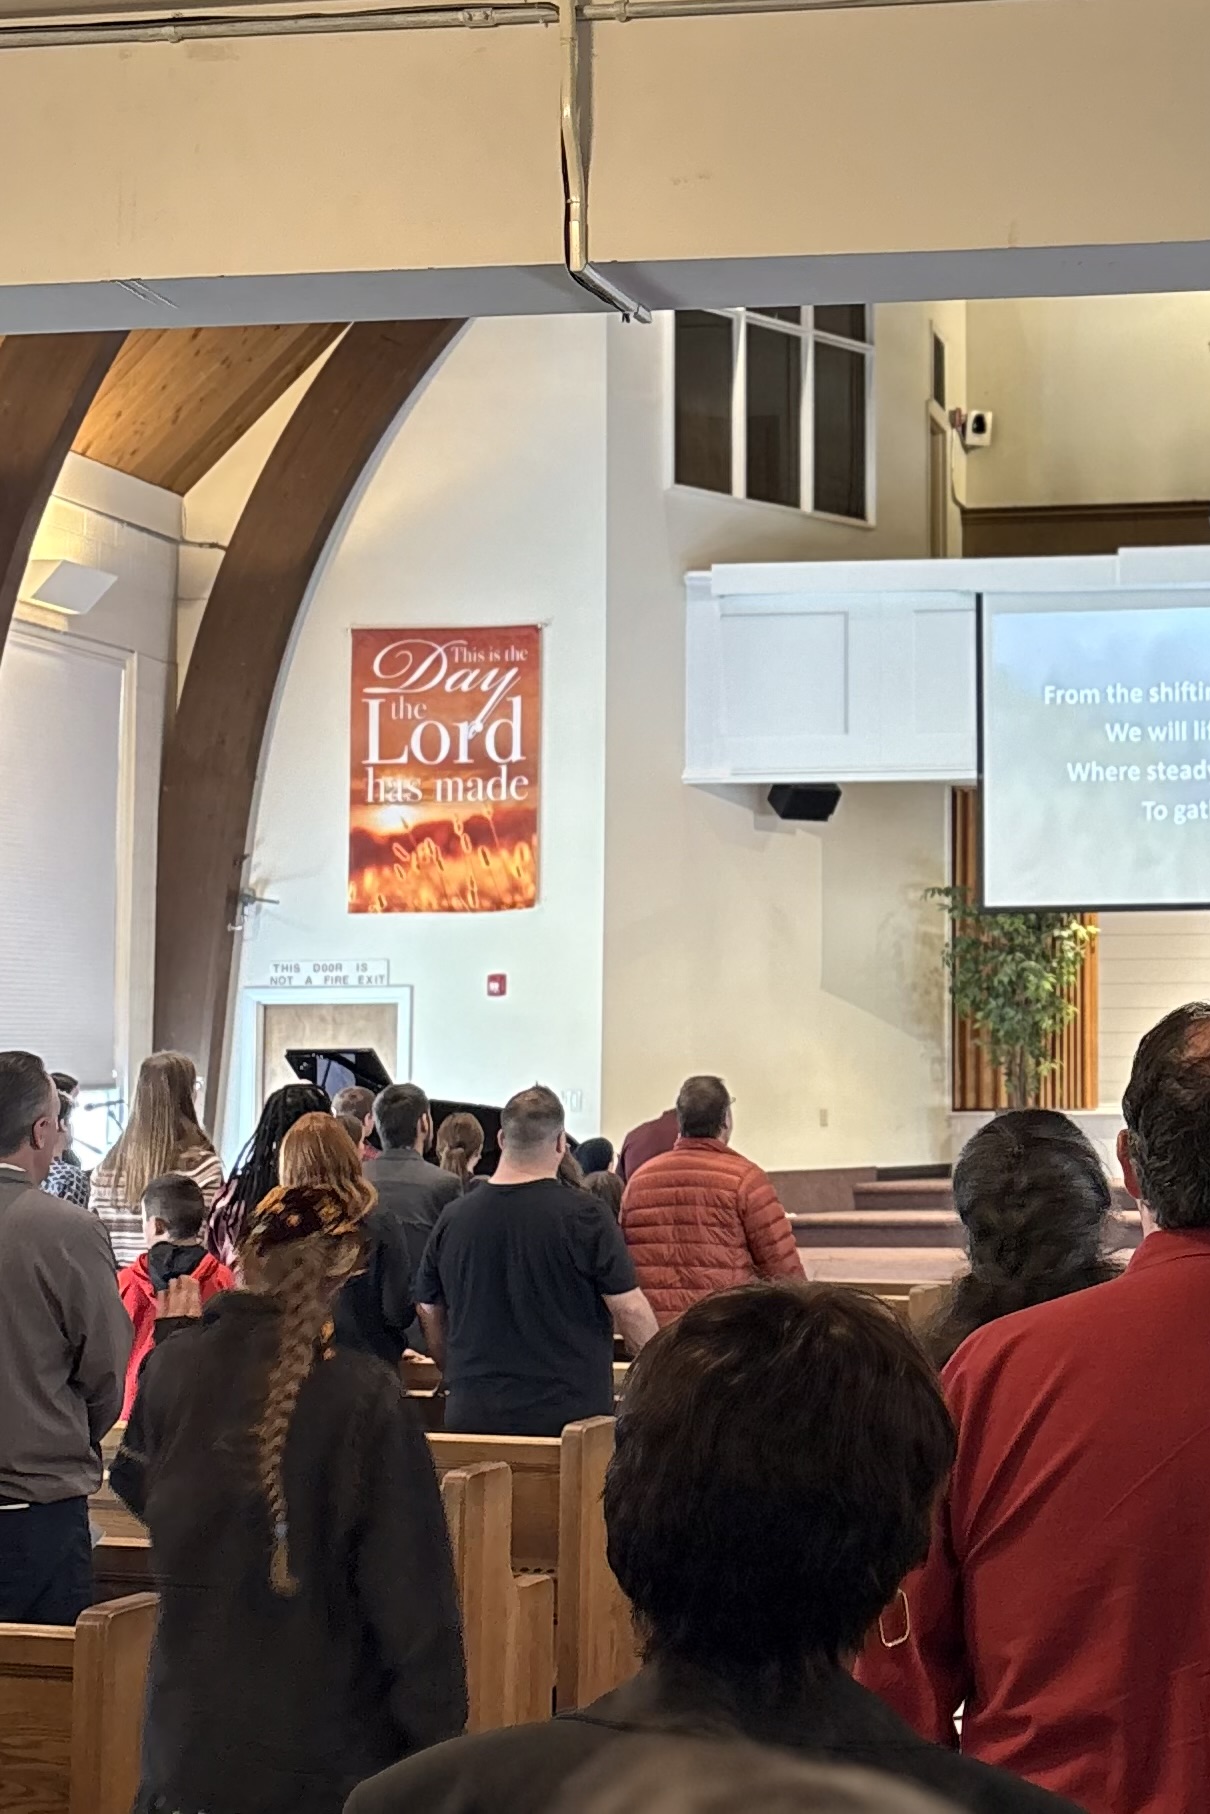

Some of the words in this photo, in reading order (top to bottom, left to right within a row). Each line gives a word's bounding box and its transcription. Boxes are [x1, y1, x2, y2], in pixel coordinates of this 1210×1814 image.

[451, 646, 484, 663] This
[489, 647, 501, 662] is
[505, 645, 528, 661] the
[363, 639, 521, 739] Day
[1044, 685, 1100, 706] From
[1106, 683, 1143, 703] the
[391, 696, 427, 720] the
[362, 695, 526, 765] Lord
[1105, 722, 1141, 743] We
[1147, 720, 1187, 742] will
[1067, 761, 1141, 783] Where
[365, 767, 422, 803] has
[436, 765, 528, 802] made
[1142, 800, 1167, 822] To
[270, 976, 293, 985] NOT
[305, 976, 312, 985] A
[324, 975, 348, 985] FIRE
[358, 974, 385, 984] EXIT
[273, 964, 300, 973] THIS
[313, 963, 342, 973] DOOR
[357, 963, 368, 972] IS
